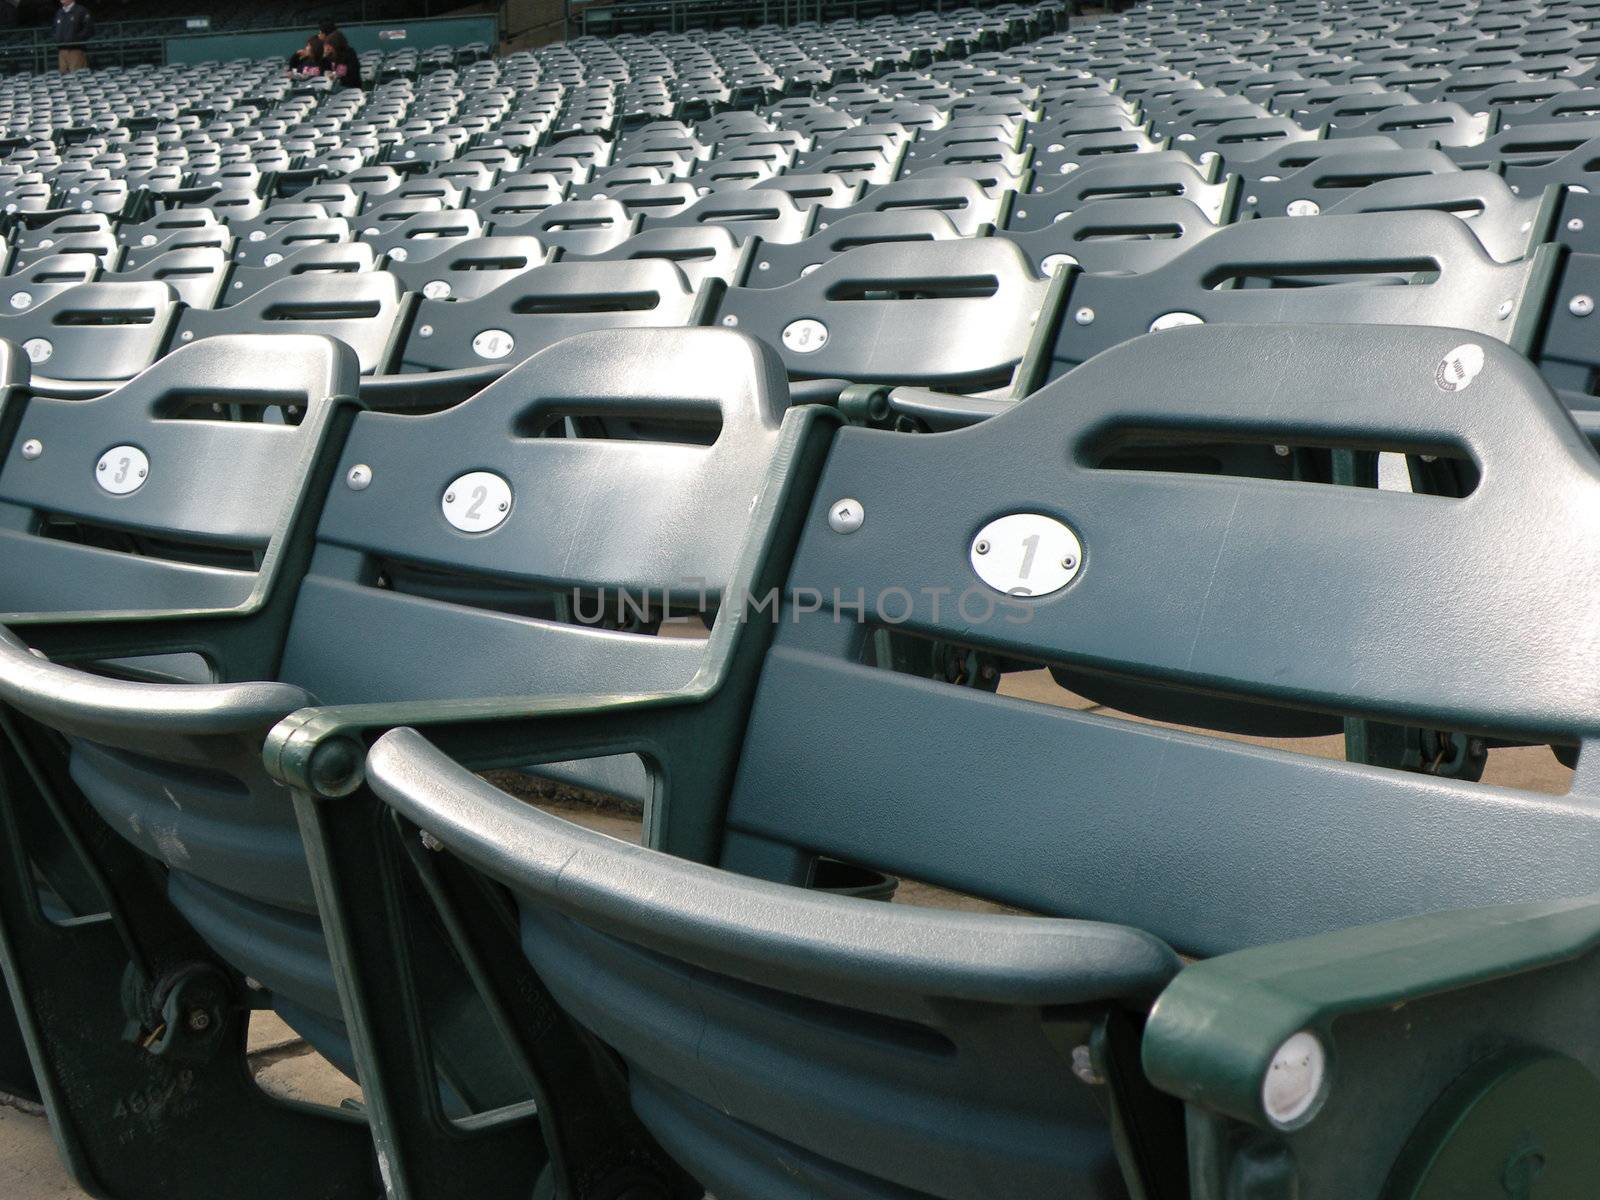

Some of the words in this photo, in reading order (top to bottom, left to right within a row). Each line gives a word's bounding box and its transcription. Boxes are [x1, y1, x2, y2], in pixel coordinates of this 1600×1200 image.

[488, 337, 499, 353] 4
[798, 327, 811, 346] 3
[114, 457, 131, 484] 3
[465, 485, 488, 520] 2
[1018, 534, 1040, 579] 1
